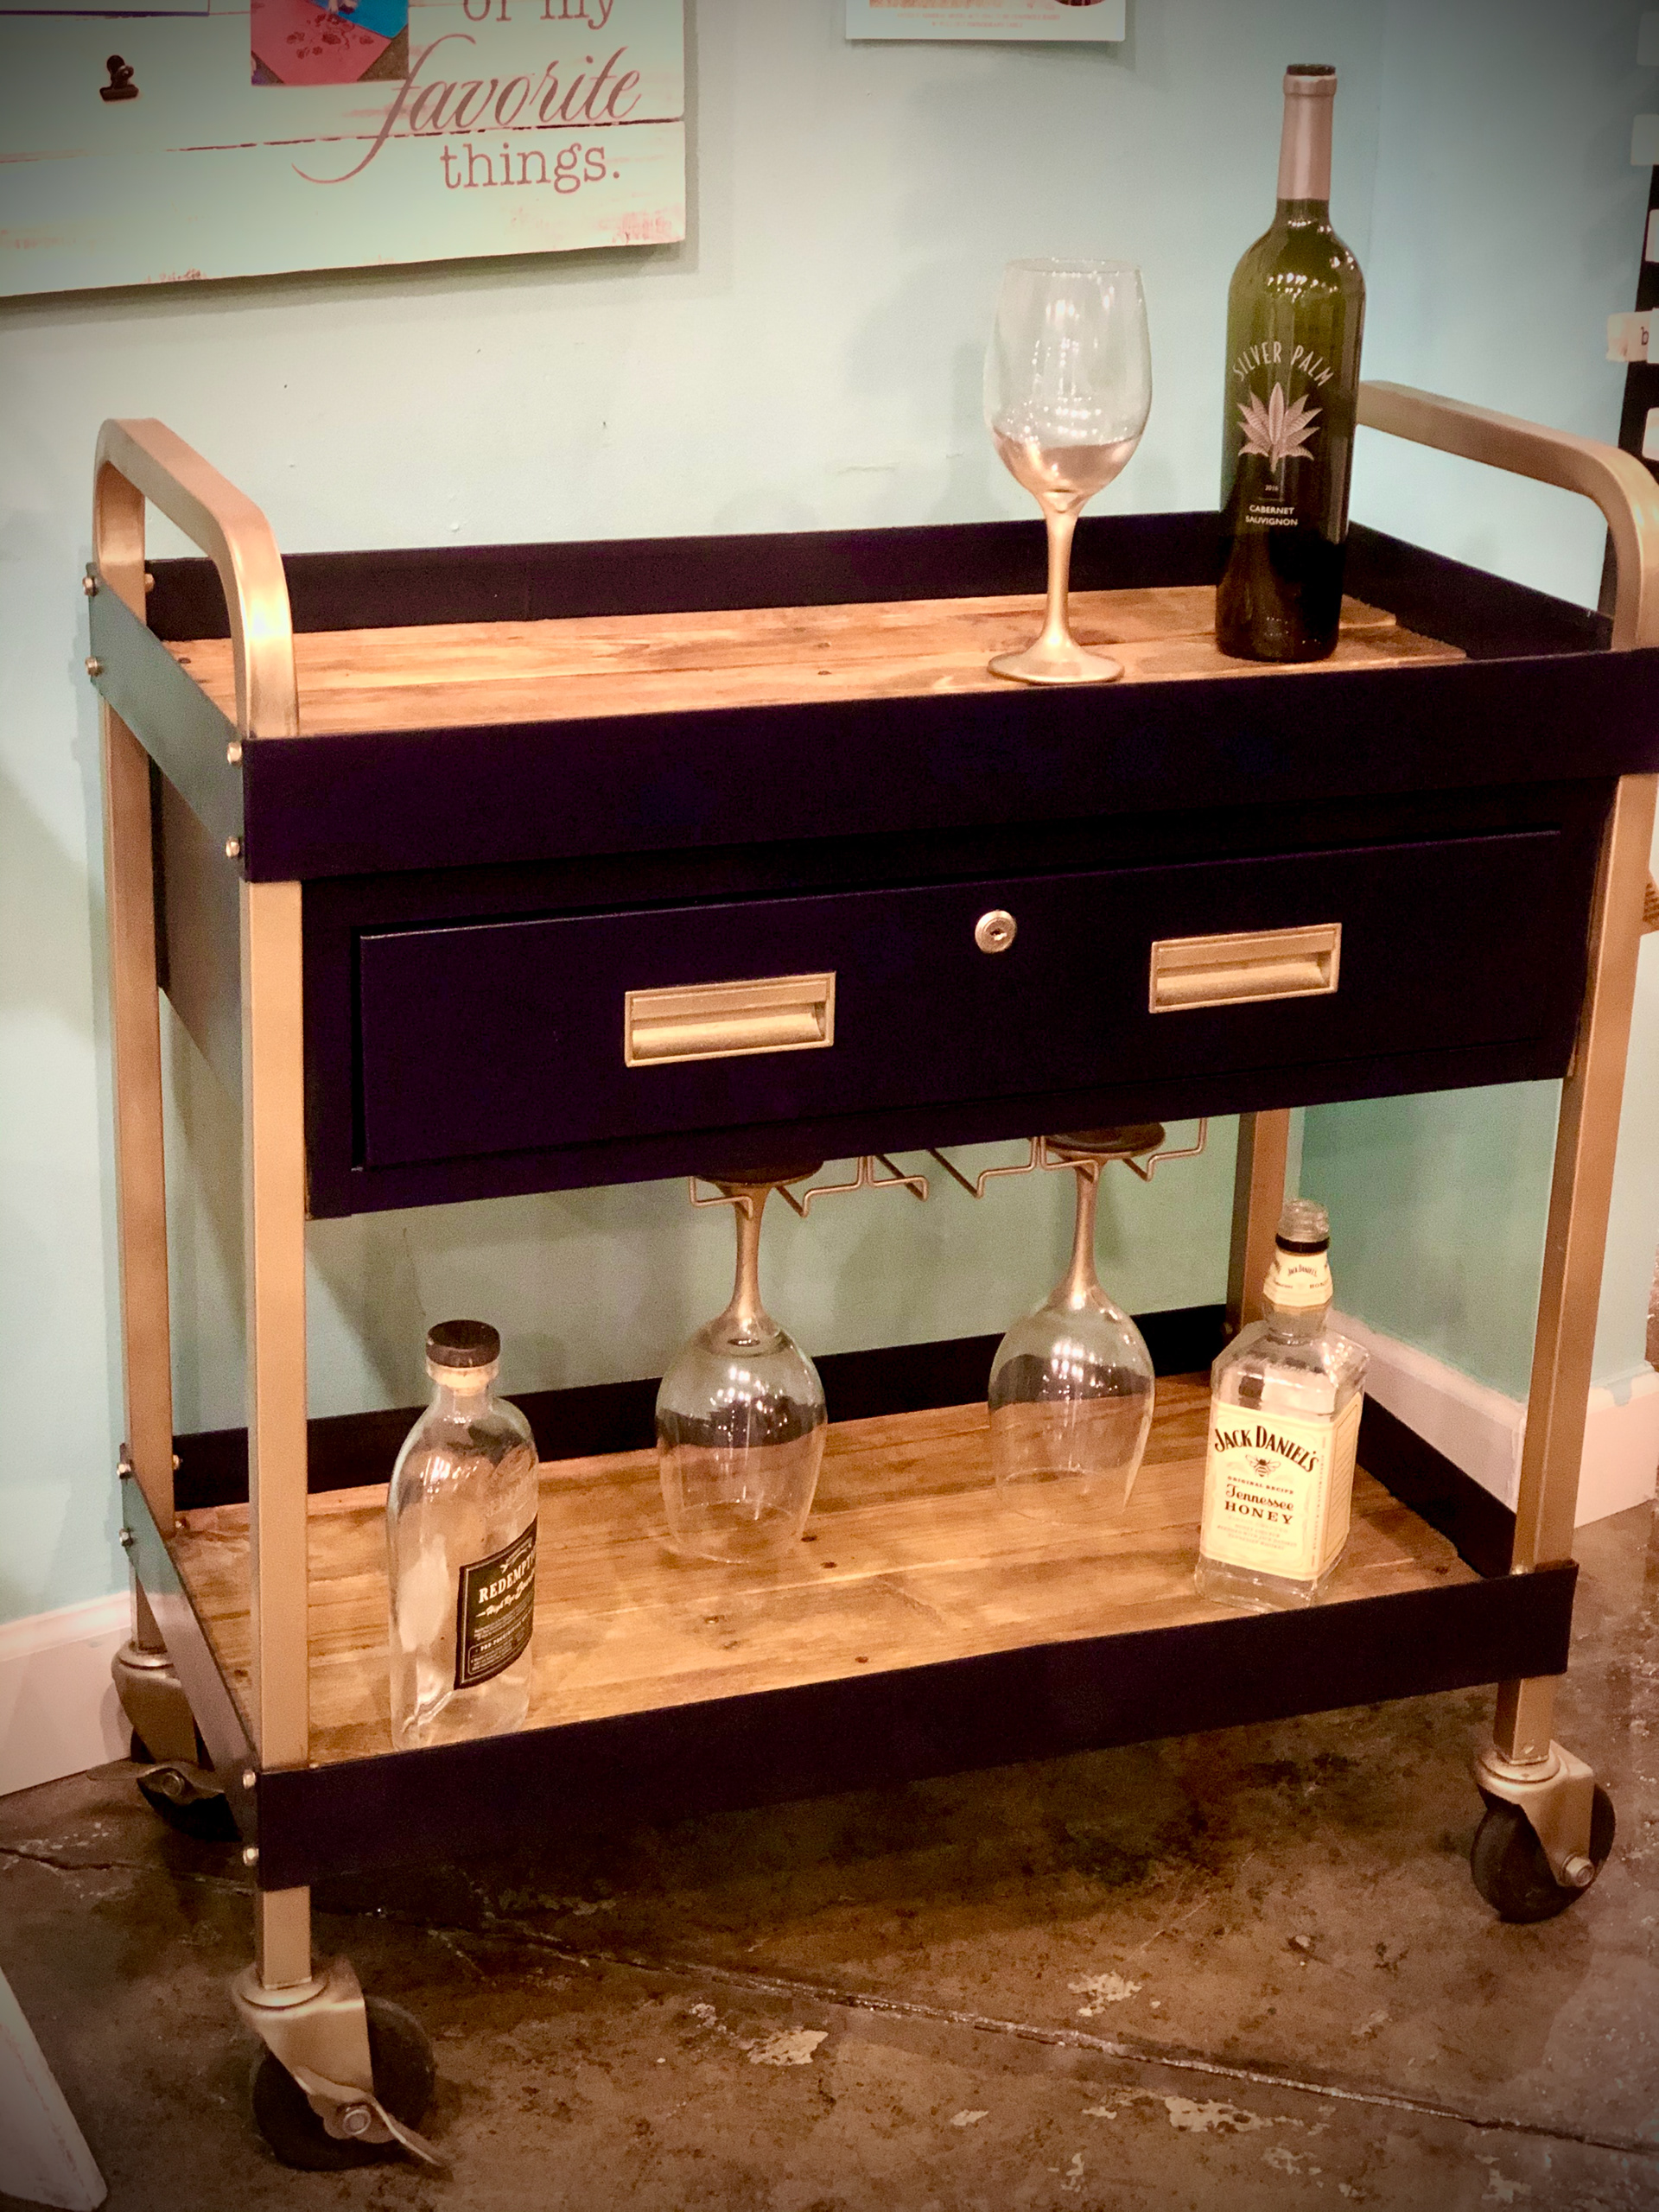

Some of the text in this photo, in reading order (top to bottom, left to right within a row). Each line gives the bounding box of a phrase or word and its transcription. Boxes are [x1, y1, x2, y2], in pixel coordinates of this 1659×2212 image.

[291, 33, 642, 184] favorite
[440, 142, 620, 194] things.
[1232, 340, 1334, 387] SILVER PALM
[1245, 515, 1298, 526] SAUVIGNON
[1249, 505, 1294, 515] CABERNET
[1214, 1425, 1319, 1473] JACK DANIEL'S
[1225, 1483, 1294, 1511] Tennessee
[1227, 1475, 1294, 1495] ORIGINAL RECIPE
[1224, 1500, 1293, 1525] HONEY
